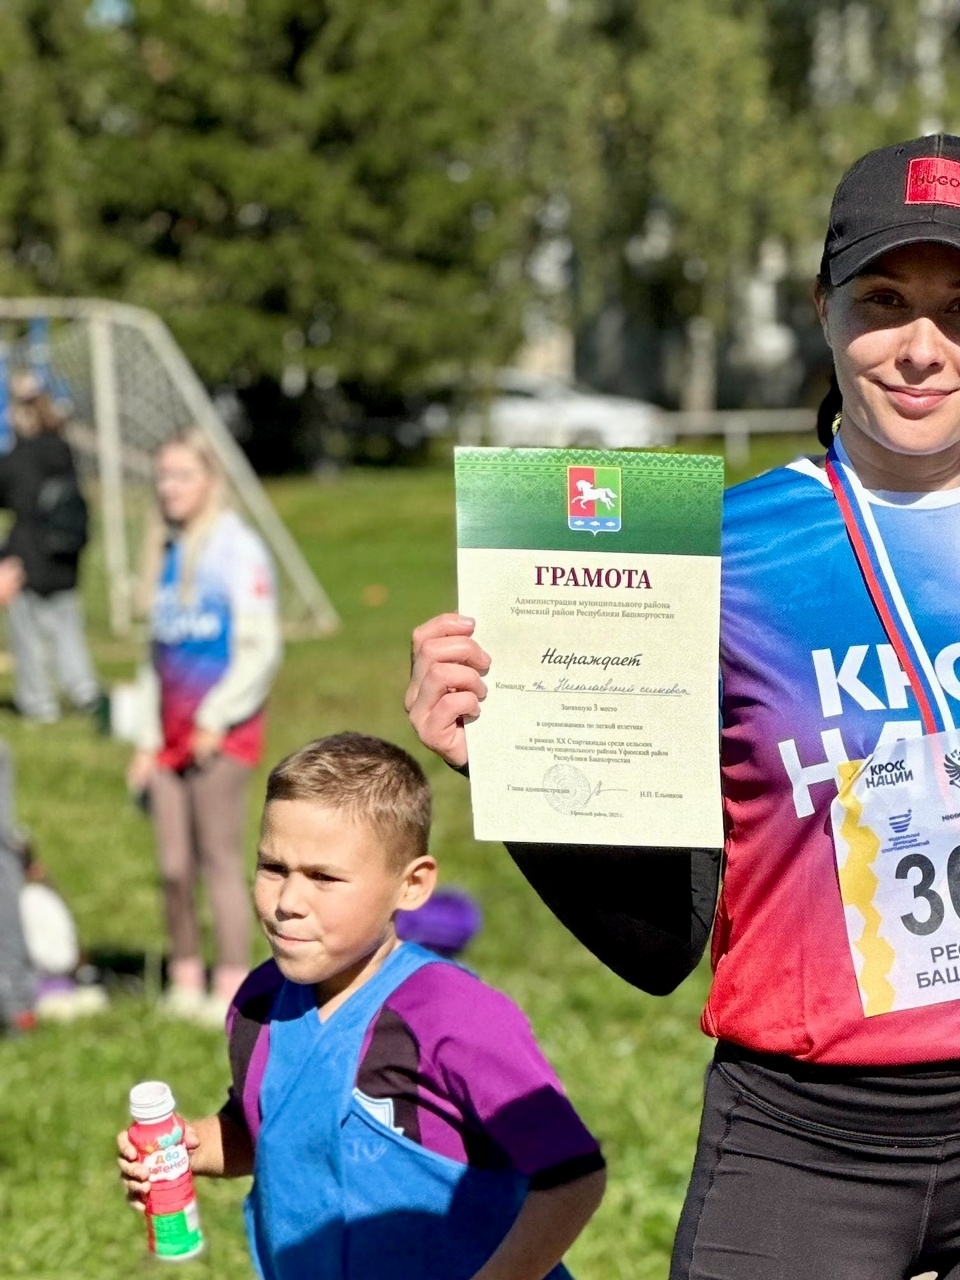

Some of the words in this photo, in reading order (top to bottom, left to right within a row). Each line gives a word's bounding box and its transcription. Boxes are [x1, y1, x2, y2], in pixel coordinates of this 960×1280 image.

[914, 174, 960, 188] HUGO
[534, 565, 653, 589] ГРАМОТА
[515, 597, 577, 607] Администрация
[578, 600, 642, 608] муниципального
[643, 601, 671, 609] района
[510, 606, 550, 616] Уфимский
[552, 608, 574, 617] район
[576, 609, 620, 618] Республики
[622, 610, 675, 620] Башкортостан
[540, 647, 643, 671] Награждает
[495, 681, 526, 691] Команду
[593, 703, 598, 711] 3
[870, 759, 906, 777] КРОСС
[865, 769, 915, 789] НАЦИИ
